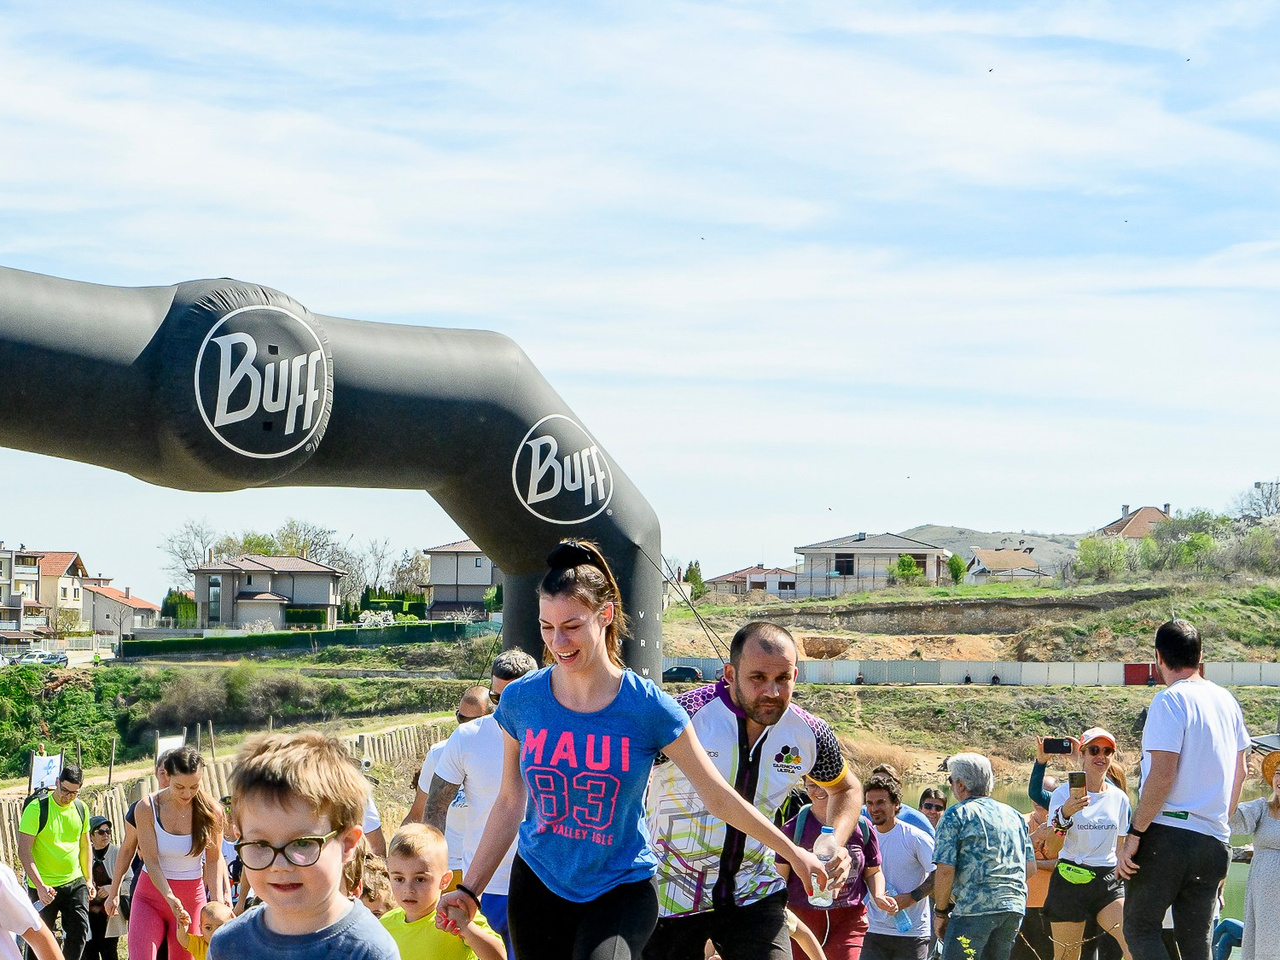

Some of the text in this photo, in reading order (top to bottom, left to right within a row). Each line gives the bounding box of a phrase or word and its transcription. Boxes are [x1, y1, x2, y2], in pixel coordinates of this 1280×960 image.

[209, 331, 322, 436] Buff
[526, 435, 607, 506] Buff
[521, 728, 630, 772] MAUI
[525, 766, 620, 830] 83
[552, 824, 589, 841] VALLEY
[591, 831, 614, 846] ISLE
